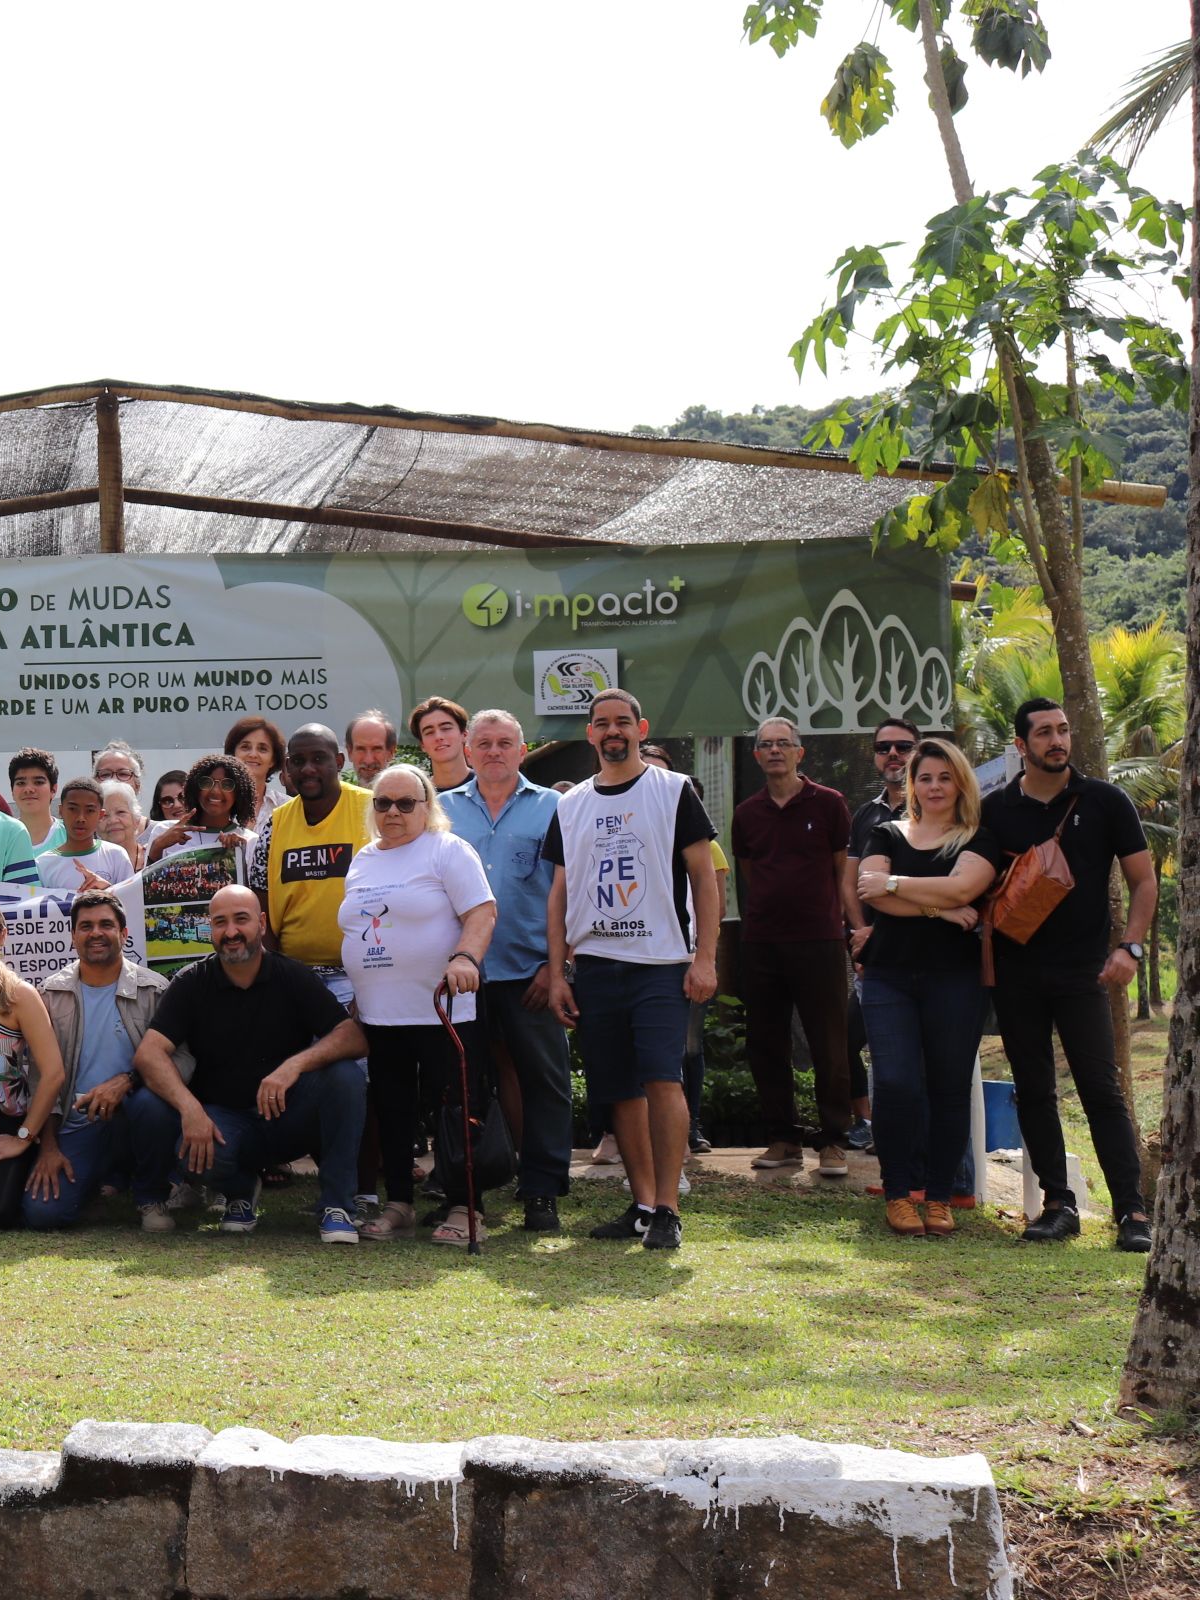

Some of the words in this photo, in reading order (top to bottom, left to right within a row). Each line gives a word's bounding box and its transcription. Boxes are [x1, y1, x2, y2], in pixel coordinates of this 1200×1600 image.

[31, 595, 55, 611] DE
[68, 585, 171, 611] MUDAS
[20, 618, 195, 649] ATLÂNTICA
[19, 673, 100, 690] UNIDOS
[108, 672, 149, 689] POR
[158, 672, 186, 688] UM
[193, 669, 273, 687] MUNDO
[281, 668, 328, 685] MAIS
[45, 699, 53, 714] E
[62, 698, 89, 715] UM
[97, 697, 125, 714] AR
[133, 696, 189, 713] PURO
[198, 695, 247, 712] PARA
[255, 693, 328, 711] TODOS
[596, 812, 633, 829] PENV
[607, 827, 621, 835] 2021
[6, 922, 44, 935] ESDE
[49, 920, 72, 934] 201
[592, 920, 606, 930] 11
[611, 920, 645, 930] anos
[366, 946, 386, 956] ABAP
